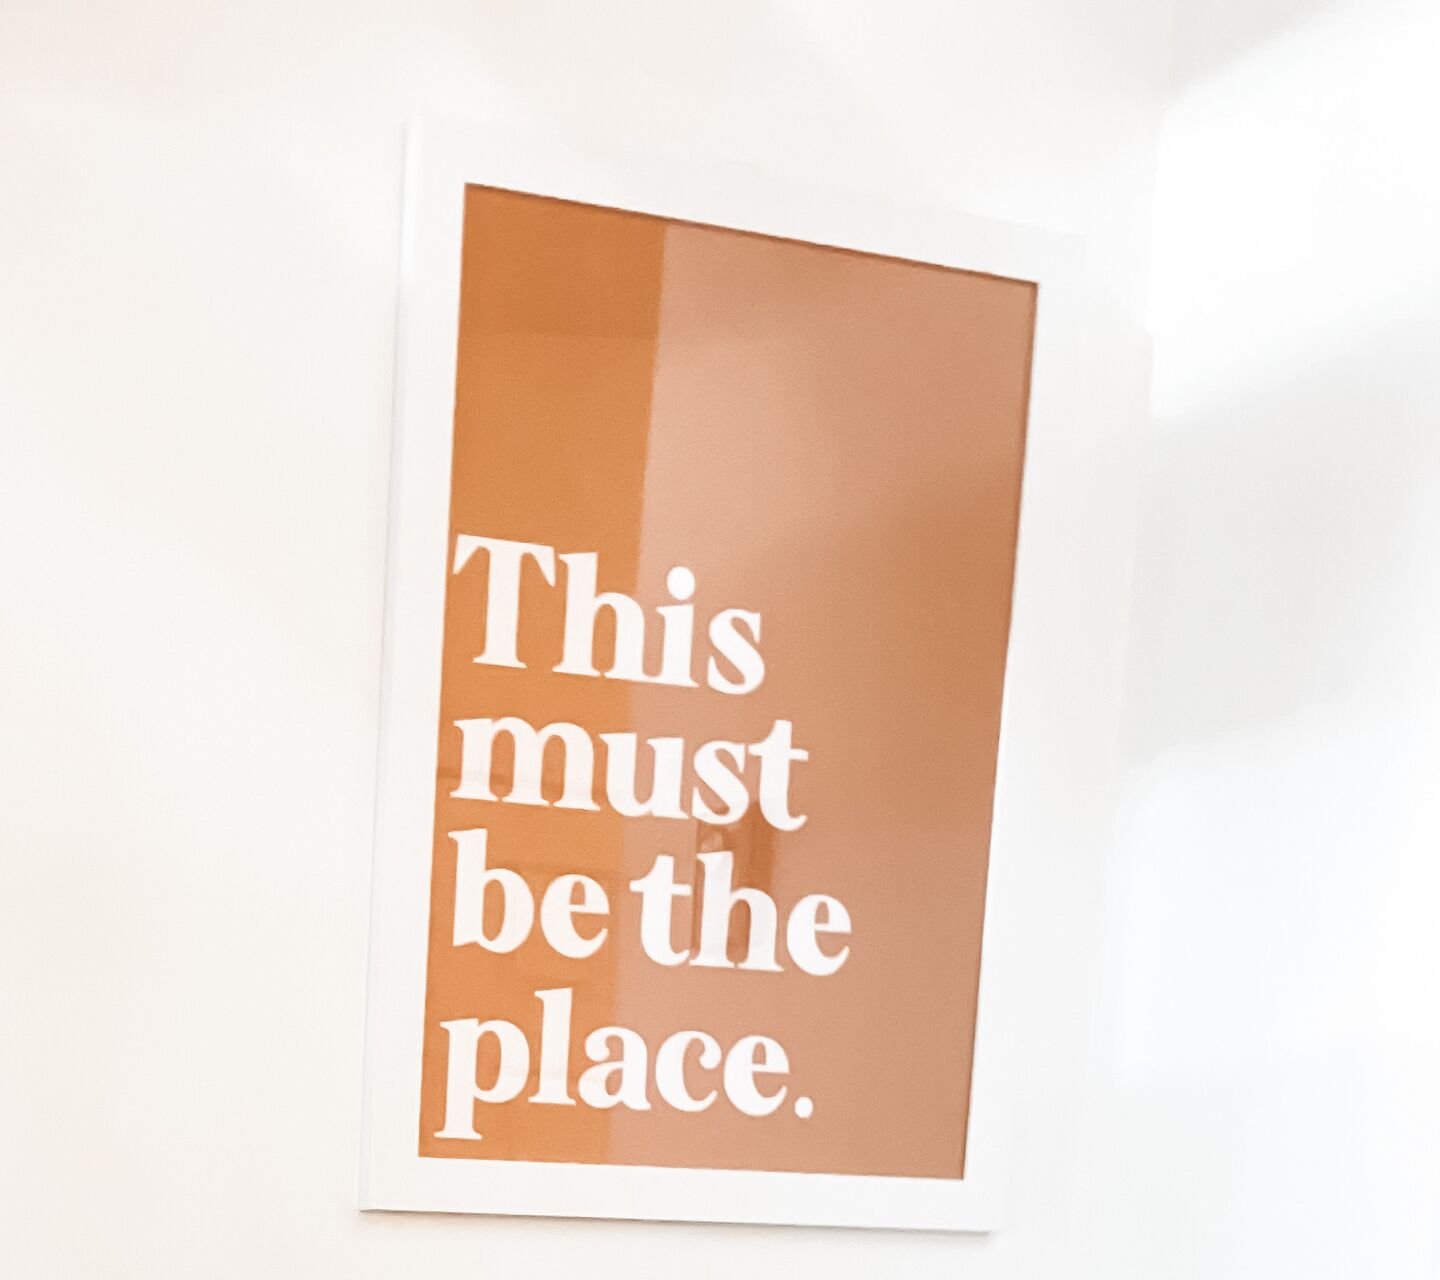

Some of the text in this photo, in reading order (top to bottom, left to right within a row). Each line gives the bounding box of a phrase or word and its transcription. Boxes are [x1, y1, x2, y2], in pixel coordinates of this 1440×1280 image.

[452, 534, 766, 695] This
[449, 714, 809, 833] must
[447, 827, 852, 977] be the
[432, 986, 815, 1141] place.
